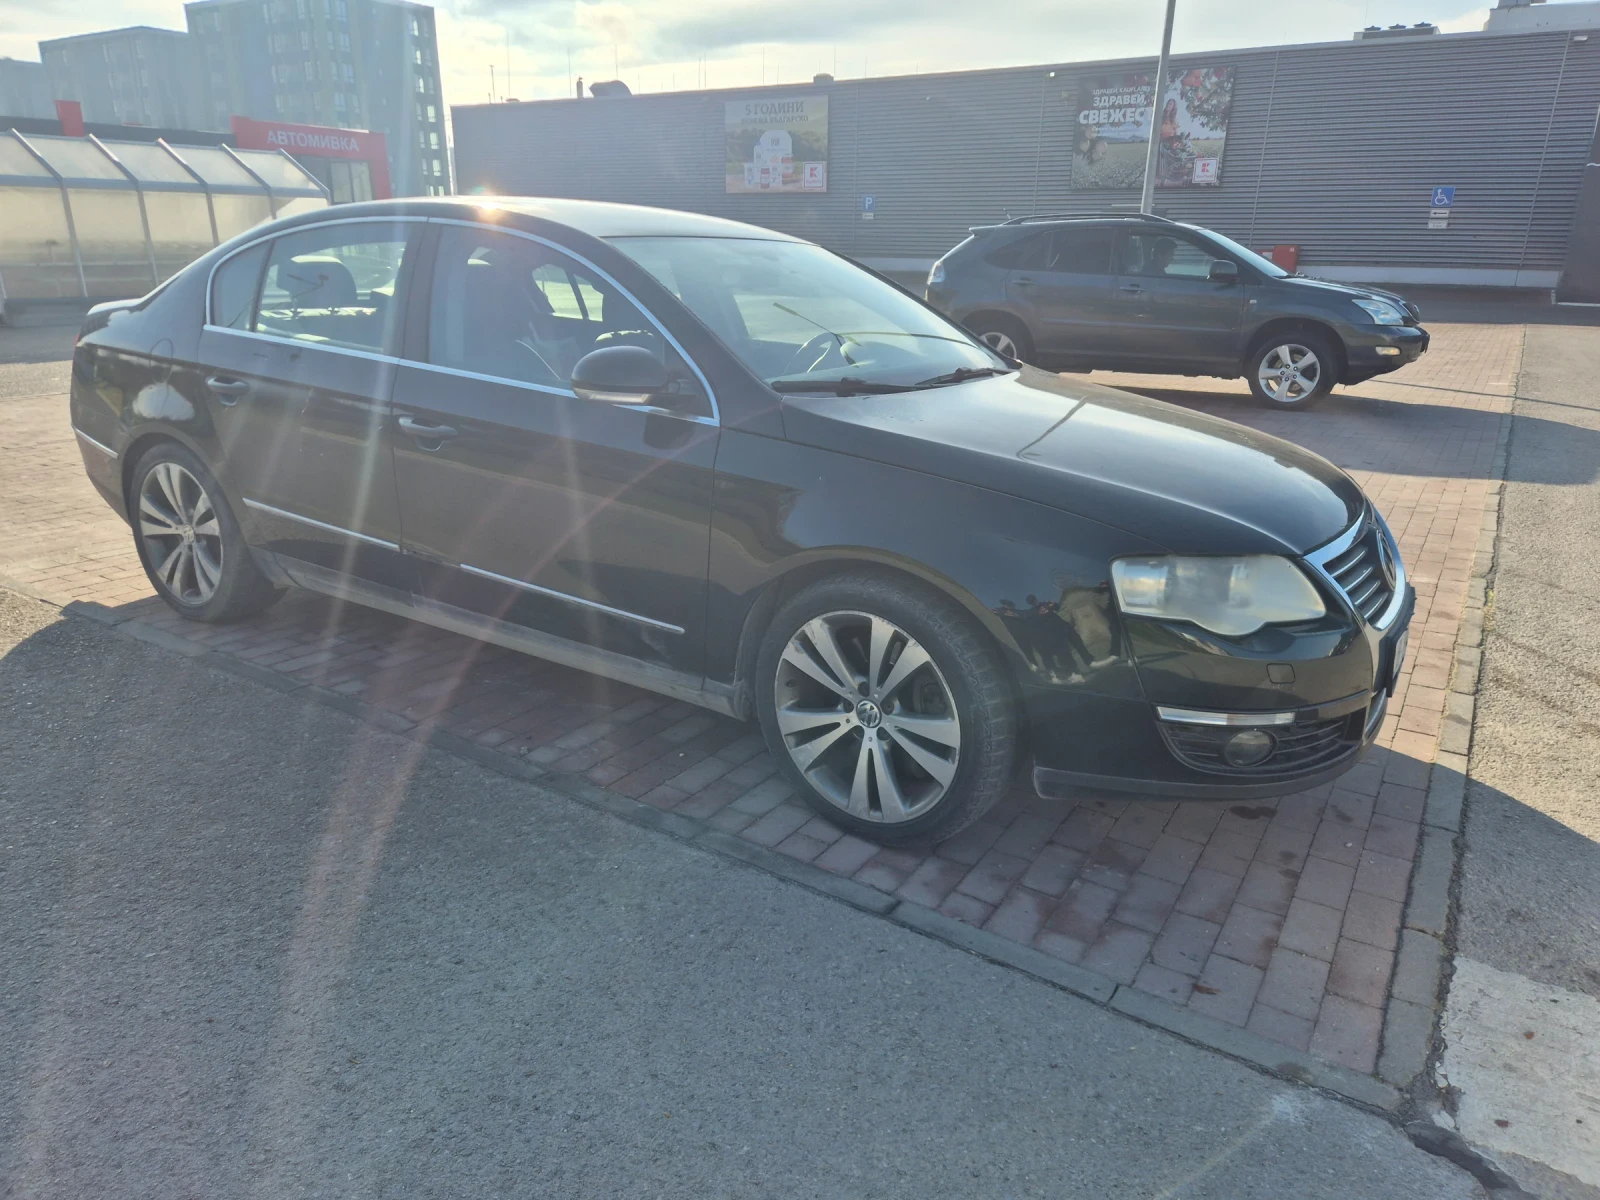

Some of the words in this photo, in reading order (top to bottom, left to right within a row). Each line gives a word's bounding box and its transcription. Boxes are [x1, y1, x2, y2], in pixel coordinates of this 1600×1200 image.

[745, 104, 752, 116] 5
[754, 101, 804, 116] ГОДИНИ
[1093, 95, 1147, 109] ЗДРАВЕЙ,
[267, 130, 359, 152] АВТОМИВКА
[865, 197, 873, 210] P
